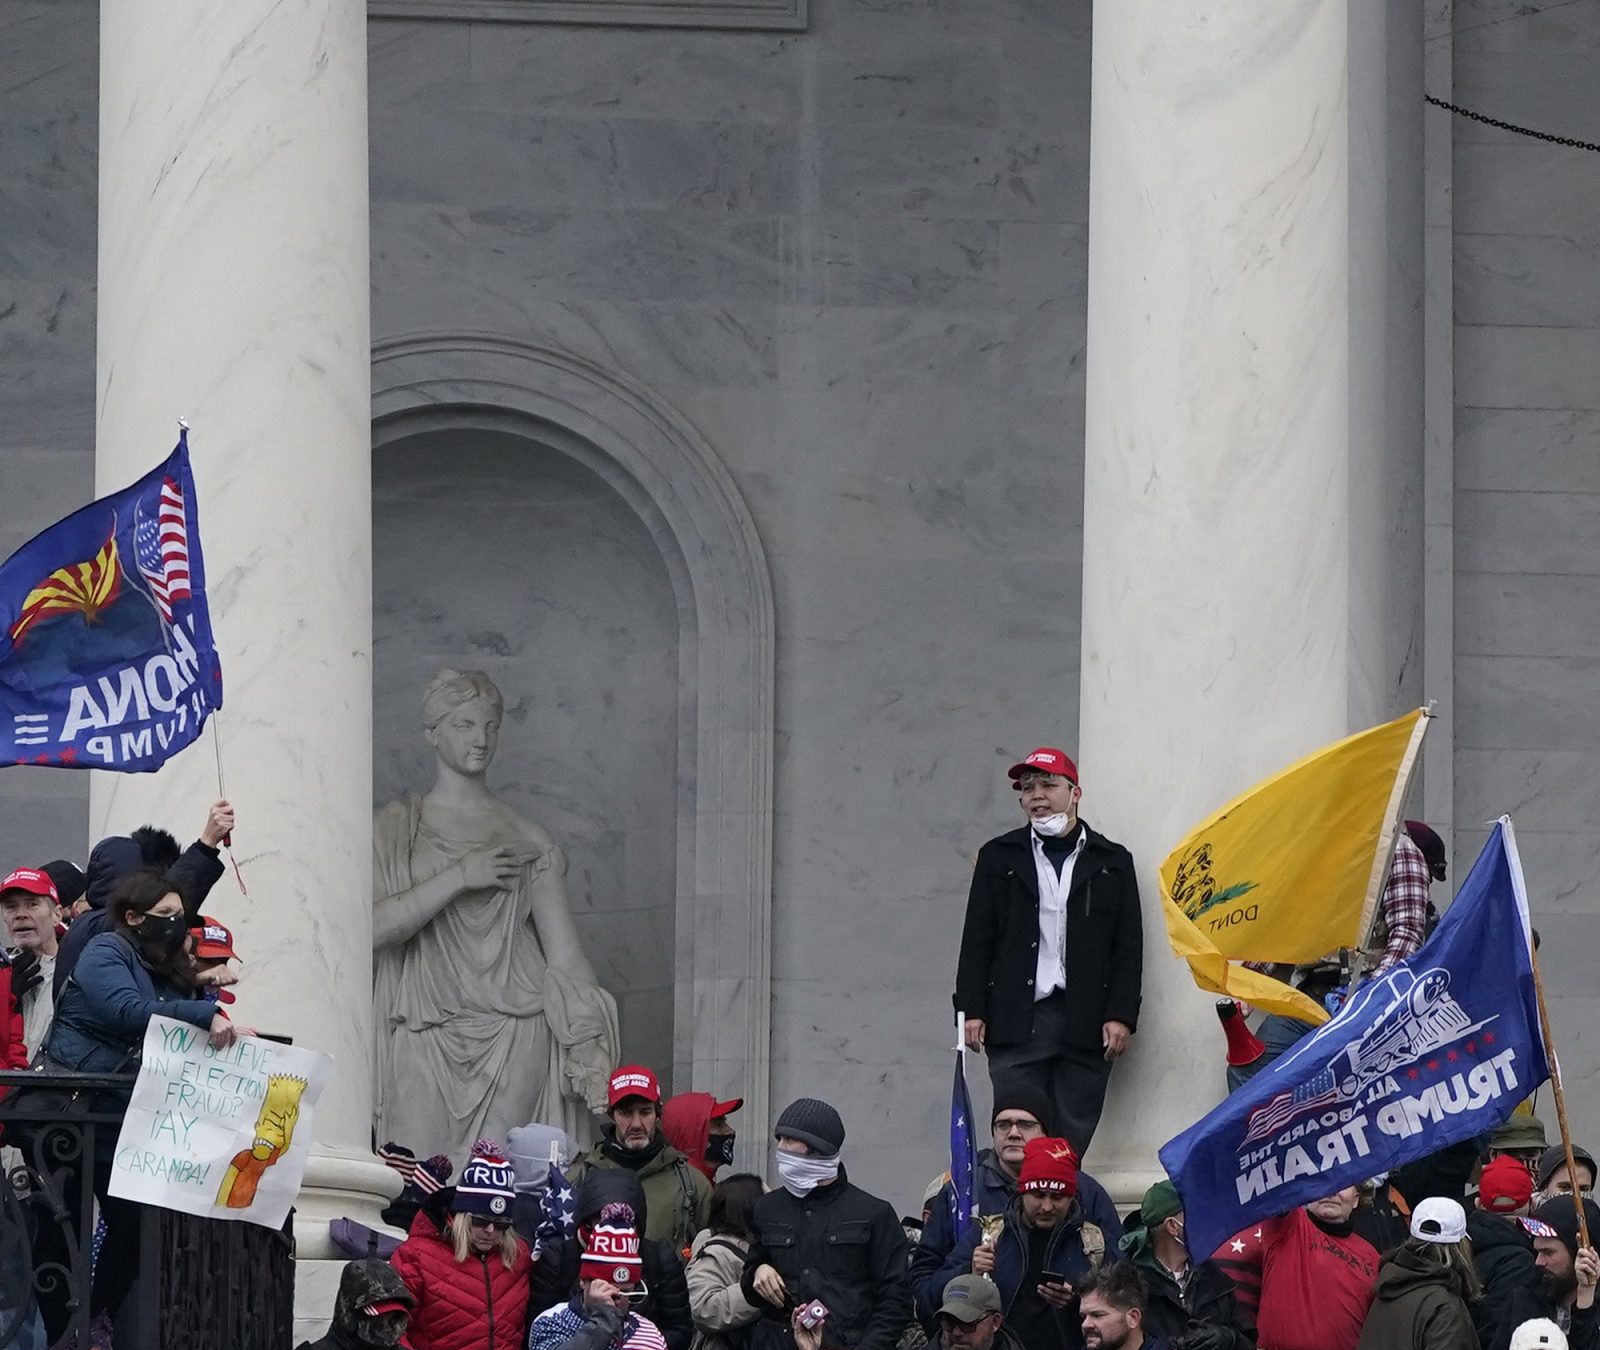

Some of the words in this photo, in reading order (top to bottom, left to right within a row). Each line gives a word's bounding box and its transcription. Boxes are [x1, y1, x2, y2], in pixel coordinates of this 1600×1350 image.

[160, 1022, 192, 1053] YOU
[180, 1061, 268, 1099] ELECTION
[164, 1082, 245, 1120] FRAUD?
[1024, 1181, 1066, 1191] TRUMP
[491, 1199, 505, 1211] 45
[613, 1269, 626, 1281] 45
